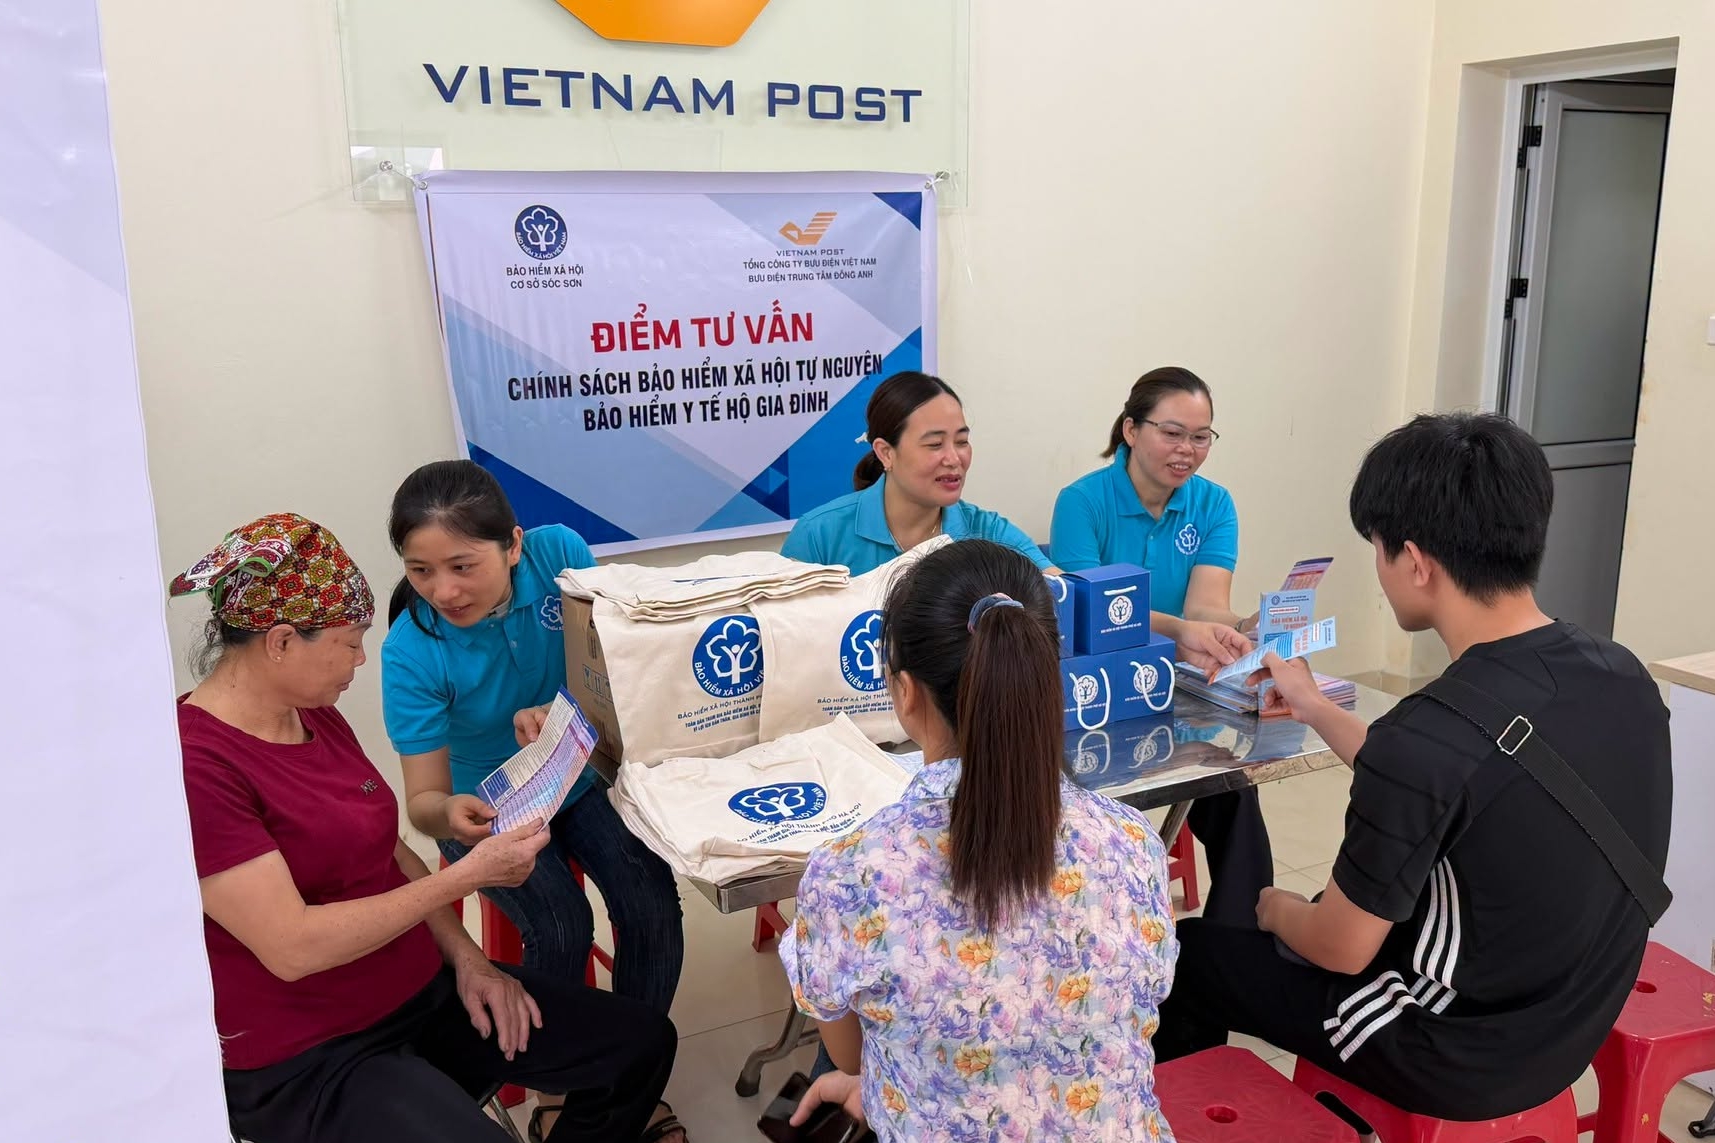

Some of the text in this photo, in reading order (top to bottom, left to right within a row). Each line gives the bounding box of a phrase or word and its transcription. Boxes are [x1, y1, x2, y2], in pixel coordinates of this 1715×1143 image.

[422, 63, 922, 122] VIETNAM POST
[743, 257, 877, 270] TỔNG CÔNG TY BƯU ĐIỆN VIỆT NAM
[776, 248, 845, 257] VIETNAM POST
[506, 262, 584, 276] BẢO HIỂM XÃ HỘI
[748, 269, 873, 283] BƯU ĐIỆN TRUNG TÂM ĐÔNG ANH
[510, 277, 582, 289] CƠ SỞ SÓC SƠN
[590, 299, 814, 353] ĐIỂM TƯ VẤN
[507, 350, 882, 401] CHÍNH SÁCH BẢO HIỂM XÃ HỘI TỰ NGUYỆN
[583, 389, 829, 432] BẢO HIỂM Y TẾ HỘ GIA ĐÌNH
[694, 661, 706, 680] BẢO
[703, 679, 721, 696] HIỂM
[722, 686, 734, 697] XÃ
[737, 681, 754, 695] HỘI
[842, 655, 850, 672] BẢO
[846, 670, 863, 689] HIỂM
[864, 680, 875, 690] XÃ
[811, 798, 825, 812] VIỆT
